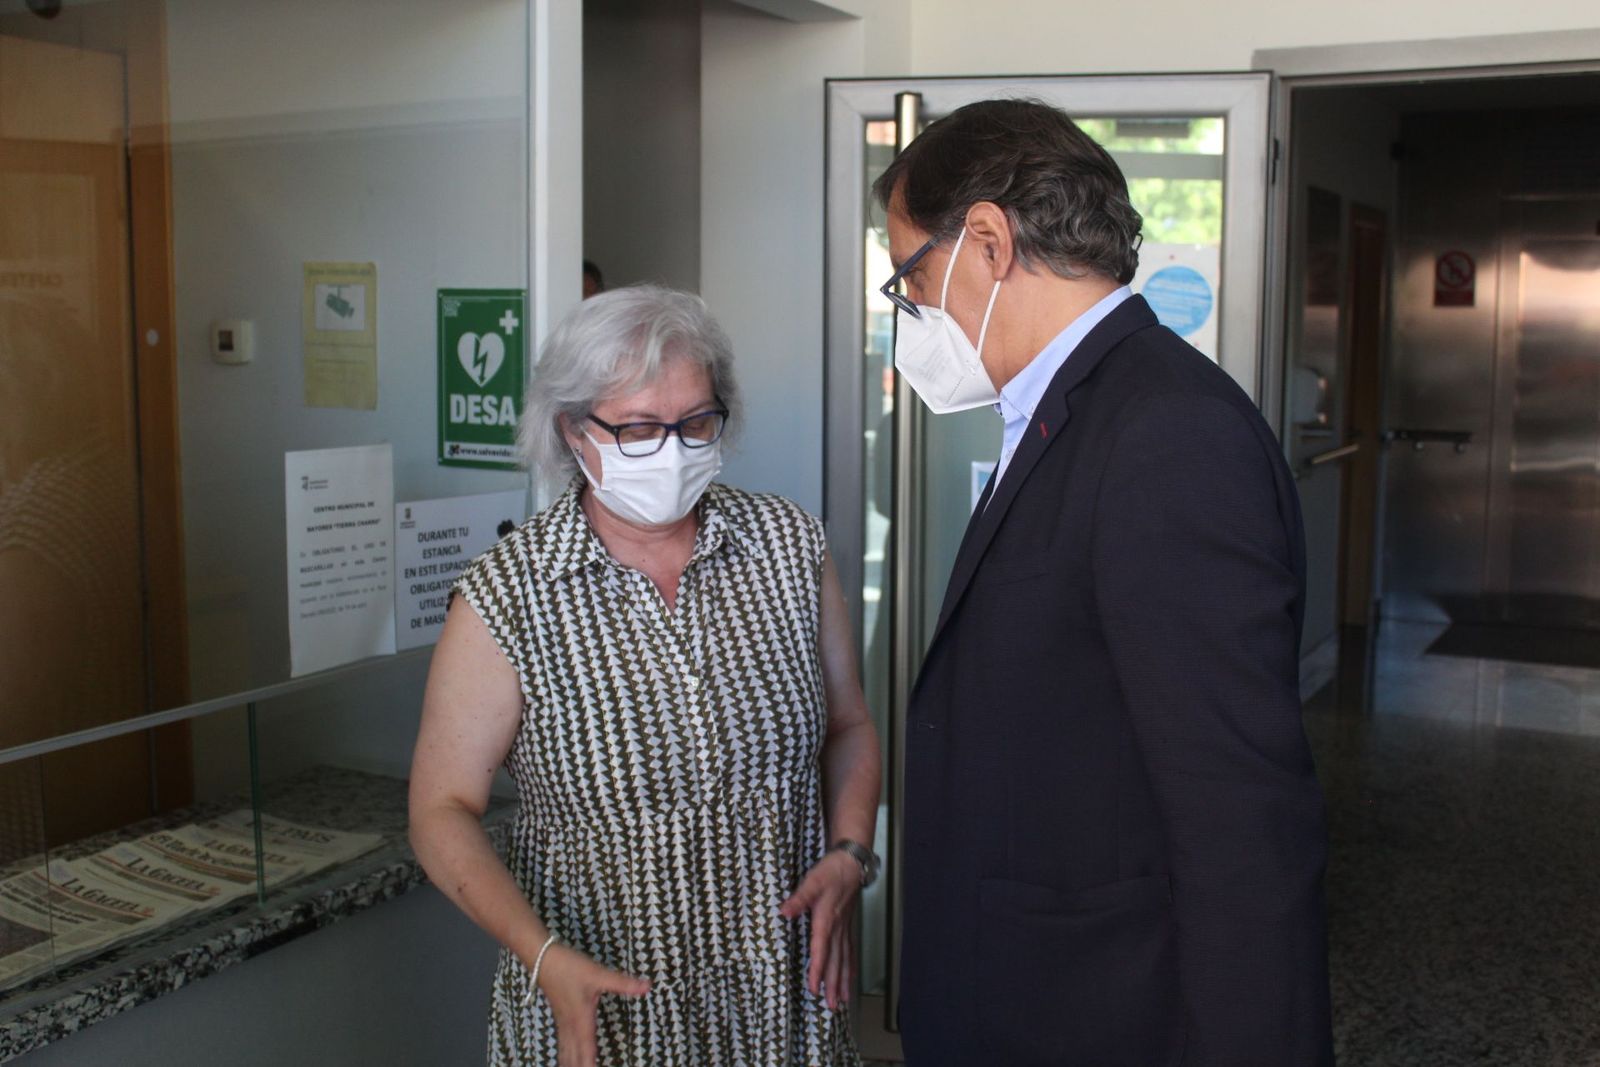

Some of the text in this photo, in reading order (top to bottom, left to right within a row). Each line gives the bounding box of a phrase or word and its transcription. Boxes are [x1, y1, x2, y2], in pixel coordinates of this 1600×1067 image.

[449, 393, 517, 426] DESA
[313, 505, 336, 514] CENTRO
[337, 501, 366, 511] MUNICIPAL
[306, 522, 333, 533] MAYORES
[417, 526, 470, 543] DURANTE TU
[422, 543, 462, 560] ESTANCIA
[403, 566, 416, 579] EN
[418, 564, 439, 577] ESTE
[409, 616, 423, 630] DE
[127, 857, 207, 892] LA GACETA
[61, 877, 86, 894] LA
[81, 888, 140, 913] GACETA
